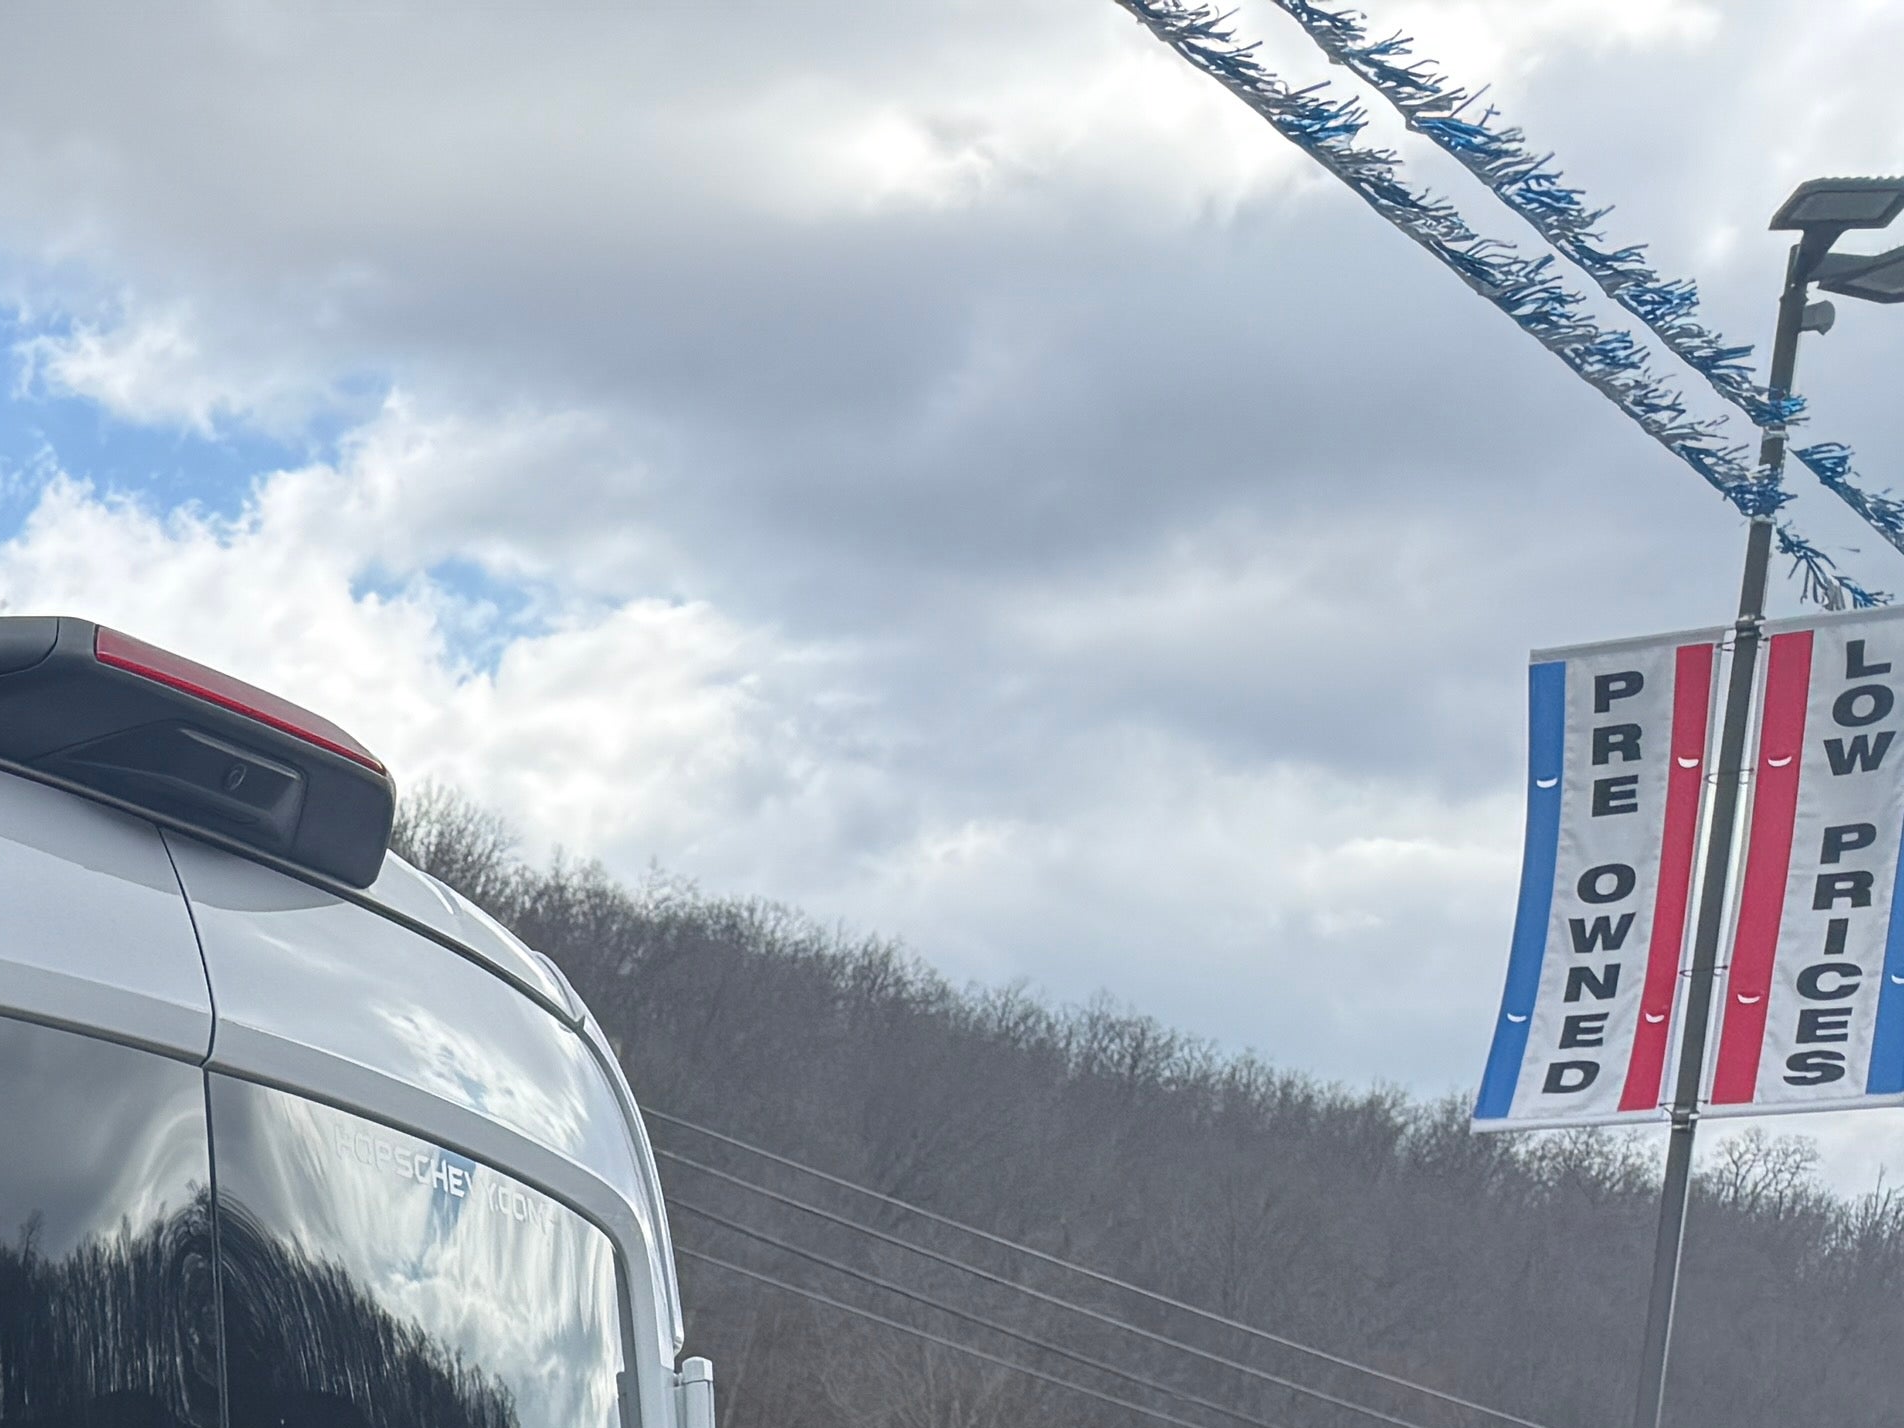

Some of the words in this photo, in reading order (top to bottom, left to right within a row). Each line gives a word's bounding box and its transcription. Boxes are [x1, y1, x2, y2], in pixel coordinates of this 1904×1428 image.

[1591, 669, 1645, 818] PRE
[1822, 638, 1897, 777] LOW
[1541, 862, 1637, 1095] OWNED
[1781, 821, 1879, 1087] PRICES
